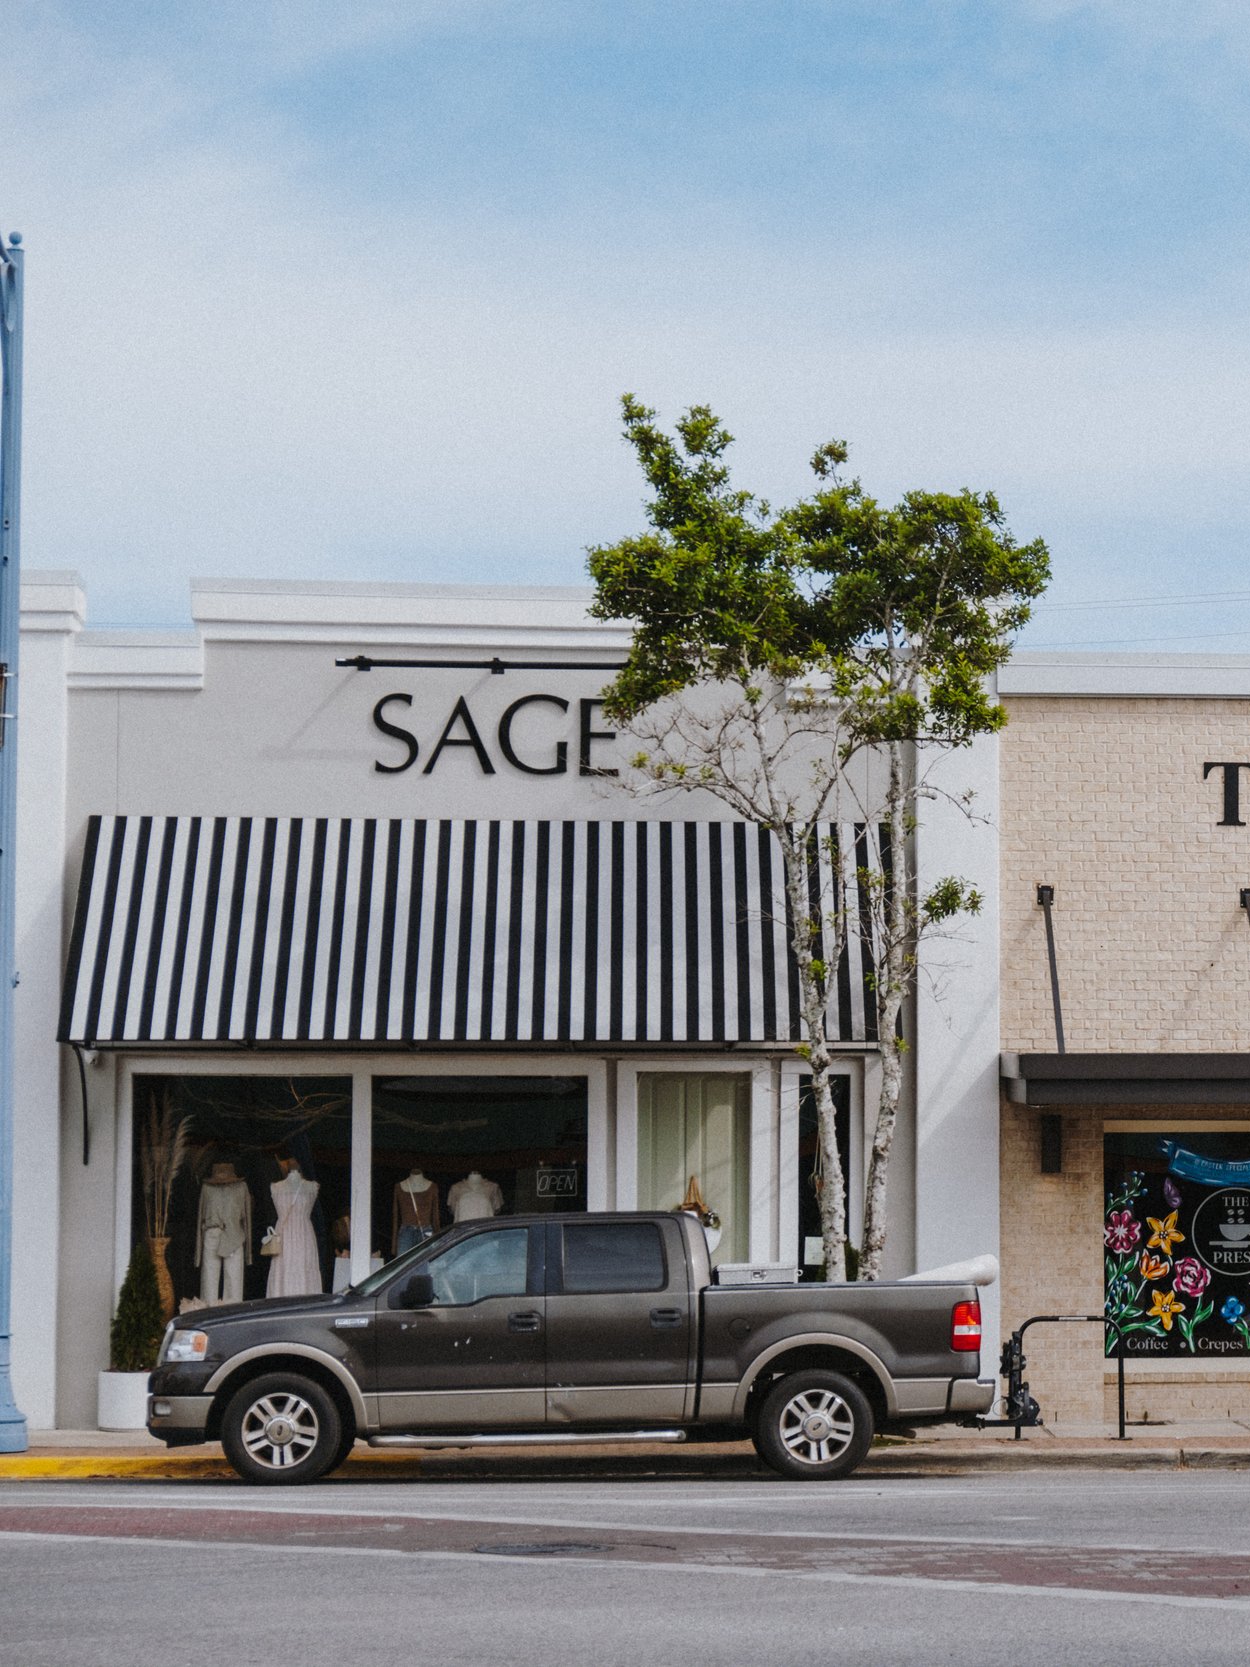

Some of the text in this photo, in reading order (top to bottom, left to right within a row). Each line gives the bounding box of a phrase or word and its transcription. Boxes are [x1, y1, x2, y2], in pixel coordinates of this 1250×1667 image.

[372, 692, 620, 777] SAGE
[538, 1175, 575, 1191] OPEN
[1222, 1196, 1249, 1207] THE
[1126, 1336, 1169, 1351] Coffee
[1197, 1337, 1243, 1353] Crepes
